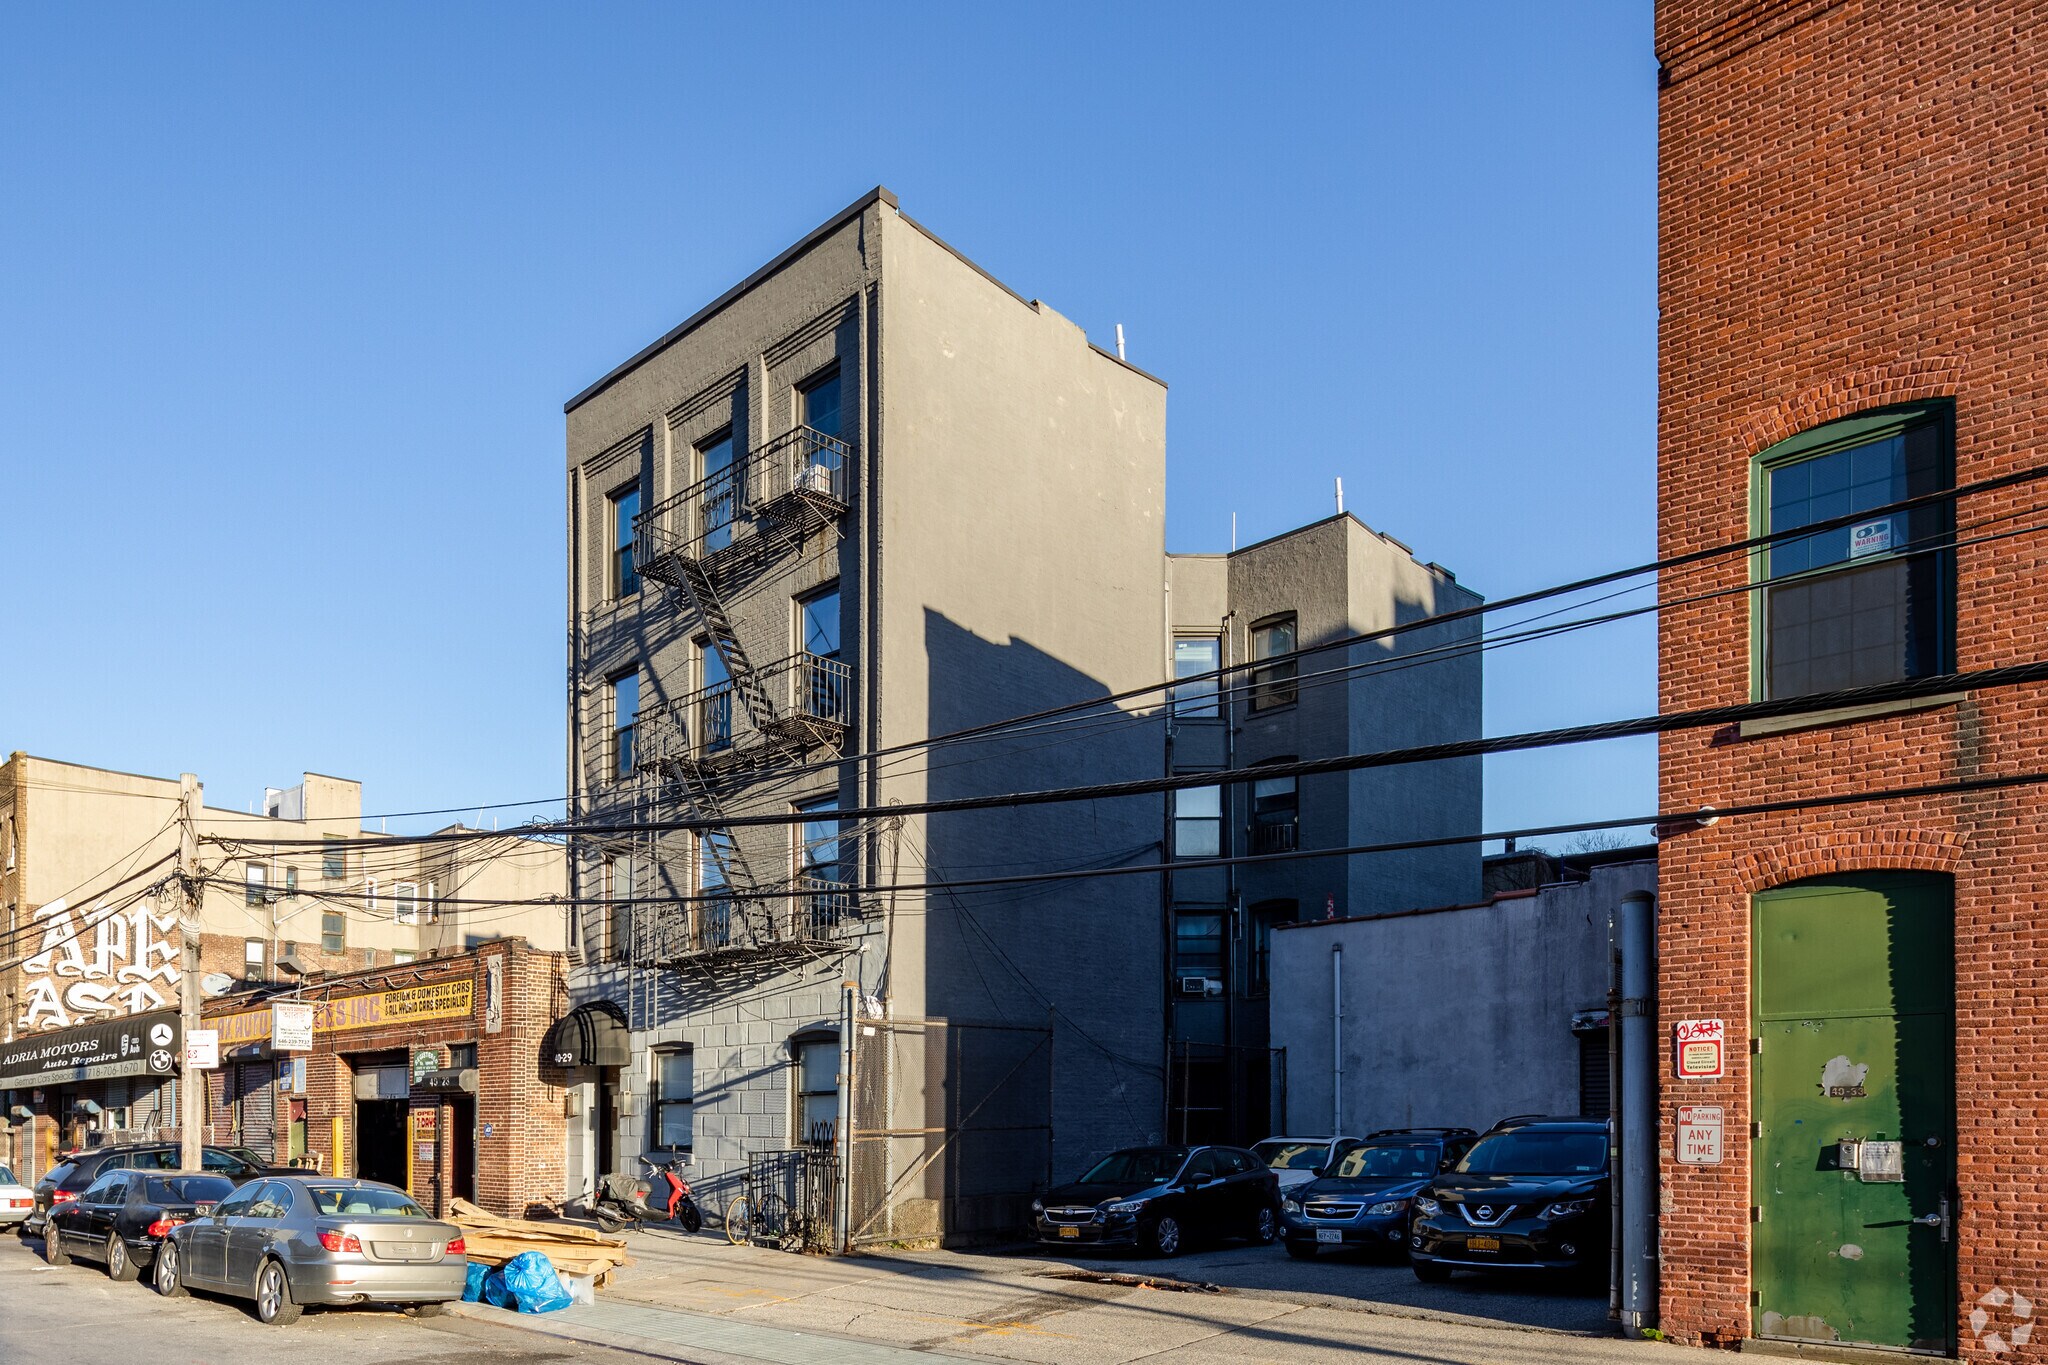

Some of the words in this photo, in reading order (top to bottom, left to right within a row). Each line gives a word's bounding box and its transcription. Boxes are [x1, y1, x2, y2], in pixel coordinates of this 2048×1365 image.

[1855, 533, 1889, 547] WARNING
[384, 990, 411, 1005] FOREIGN
[411, 989, 417, 1000] &
[417, 984, 450, 999] DOMESTIC
[451, 981, 470, 995] CARS
[389, 1003, 398, 1015] ALL
[418, 999, 434, 1012] CARS
[435, 994, 469, 1010] SPECIALIST
[235, 1011, 268, 1038] AUTO
[2, 1050, 38, 1065] ADRIA
[39, 1039, 99, 1059] MOTORS
[42, 1059, 69, 1069] Auto
[70, 1052, 118, 1066] Repairs
[14, 1077, 37, 1087] German
[37, 1074, 51, 1084] Cars
[87, 1062, 139, 1078] 718-706-1670
[1831, 1087, 1864, 1096] 40-33
[1680, 1110, 1692, 1122] NO
[1693, 1113, 1721, 1121] PARKING
[1688, 1129, 1713, 1140] ANY
[1687, 1143, 1714, 1155] TIME
